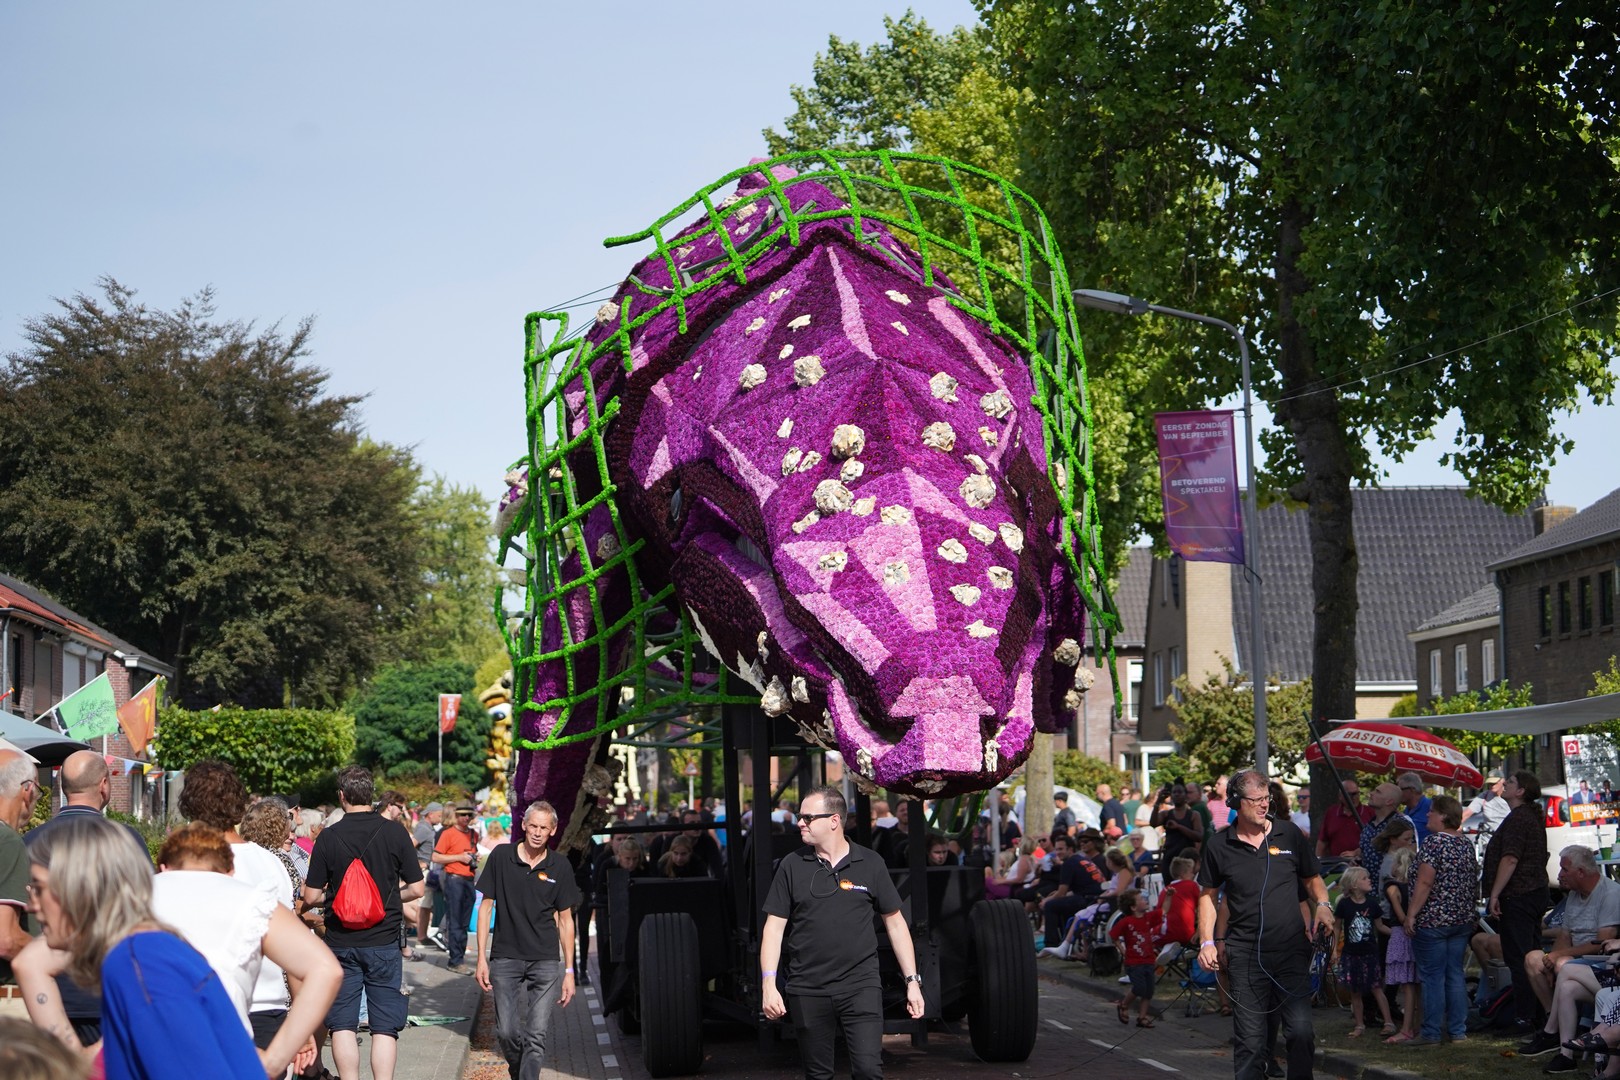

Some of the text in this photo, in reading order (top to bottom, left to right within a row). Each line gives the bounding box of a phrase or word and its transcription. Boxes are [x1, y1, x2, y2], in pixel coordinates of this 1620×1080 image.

[1162, 421, 1228, 432] EERSTE ZONDAG
[1163, 430, 1229, 440] VAN SEPTEMBER
[1171, 477, 1226, 487] BETOVEREND
[1180, 486, 1226, 495] SPEKTAKEL!
[1343, 730, 1446, 758] BASTOS BASTOS
